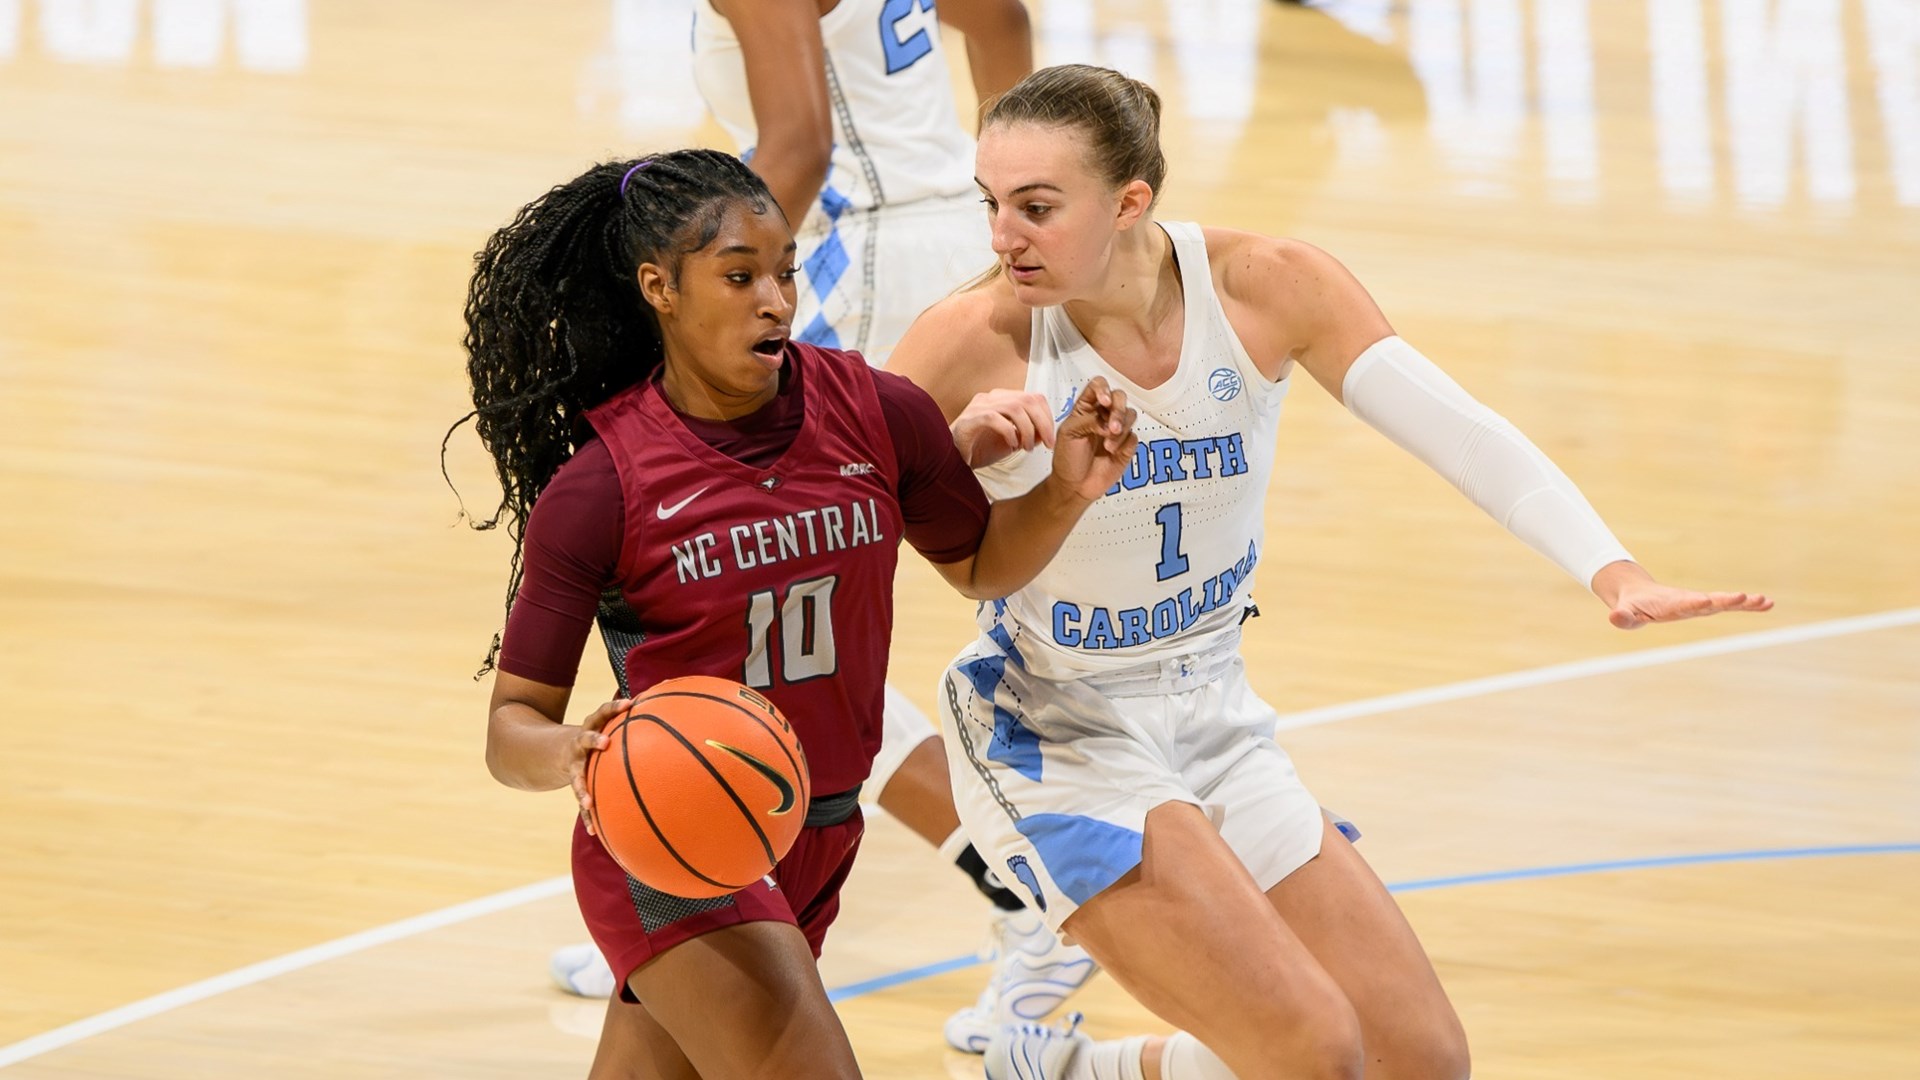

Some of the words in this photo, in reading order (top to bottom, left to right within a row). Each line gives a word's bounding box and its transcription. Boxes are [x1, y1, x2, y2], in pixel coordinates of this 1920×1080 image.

[1105, 432, 1248, 496] ORTH
[671, 532, 722, 584] NC
[729, 498, 884, 570] CENTRAL
[1155, 502, 1189, 582] 1
[742, 575, 839, 689] 10
[1052, 538, 1257, 649] CAROLINA
